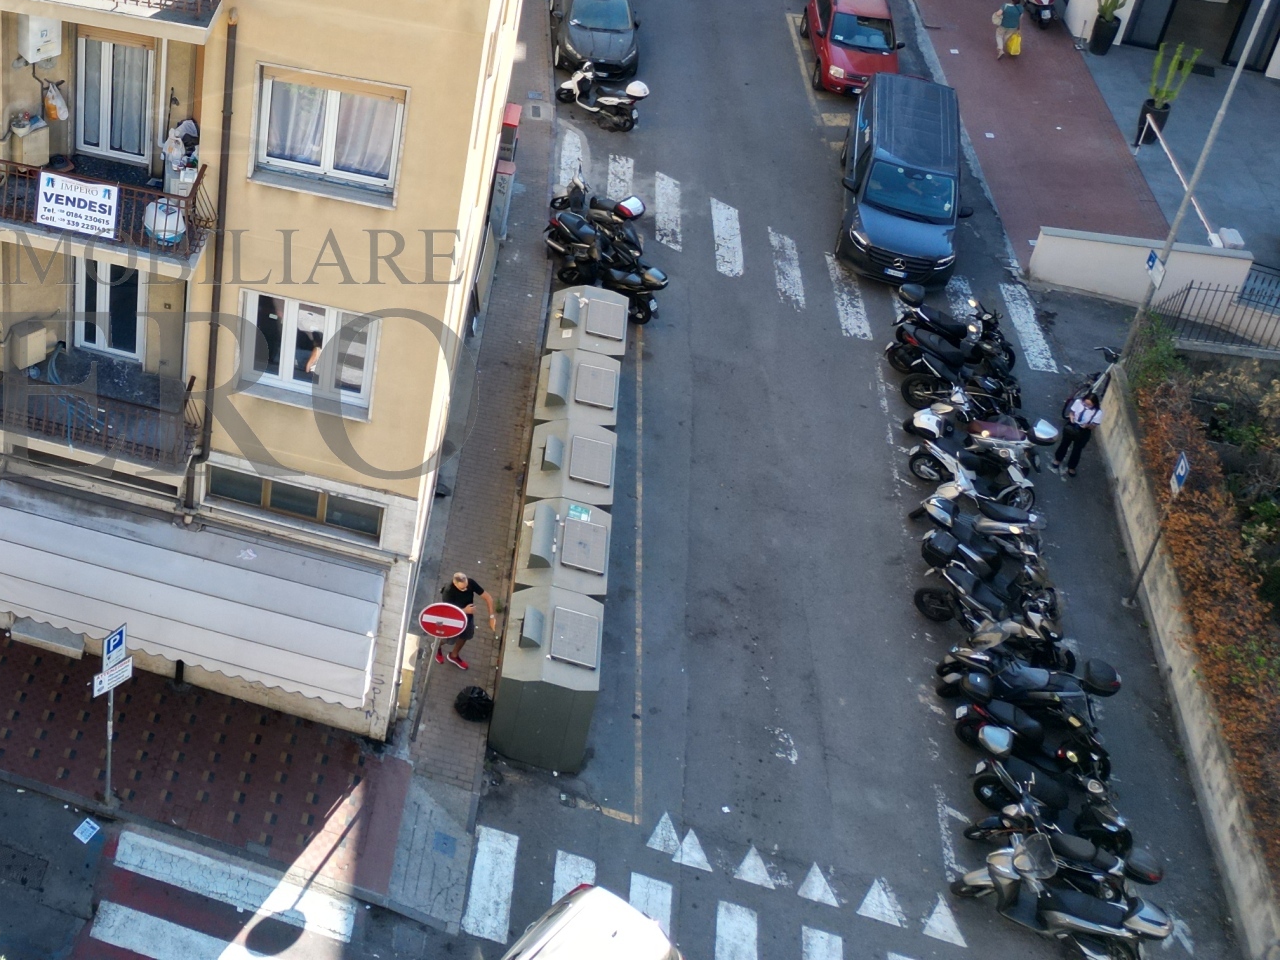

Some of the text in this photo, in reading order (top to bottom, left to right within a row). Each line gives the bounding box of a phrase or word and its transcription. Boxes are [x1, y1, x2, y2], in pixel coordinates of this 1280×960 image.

[61, 183, 98, 196] IMPERO
[43, 191, 113, 216] VENDESI
[66, 211, 82, 219] 0184
[110, 635, 120, 651] P
